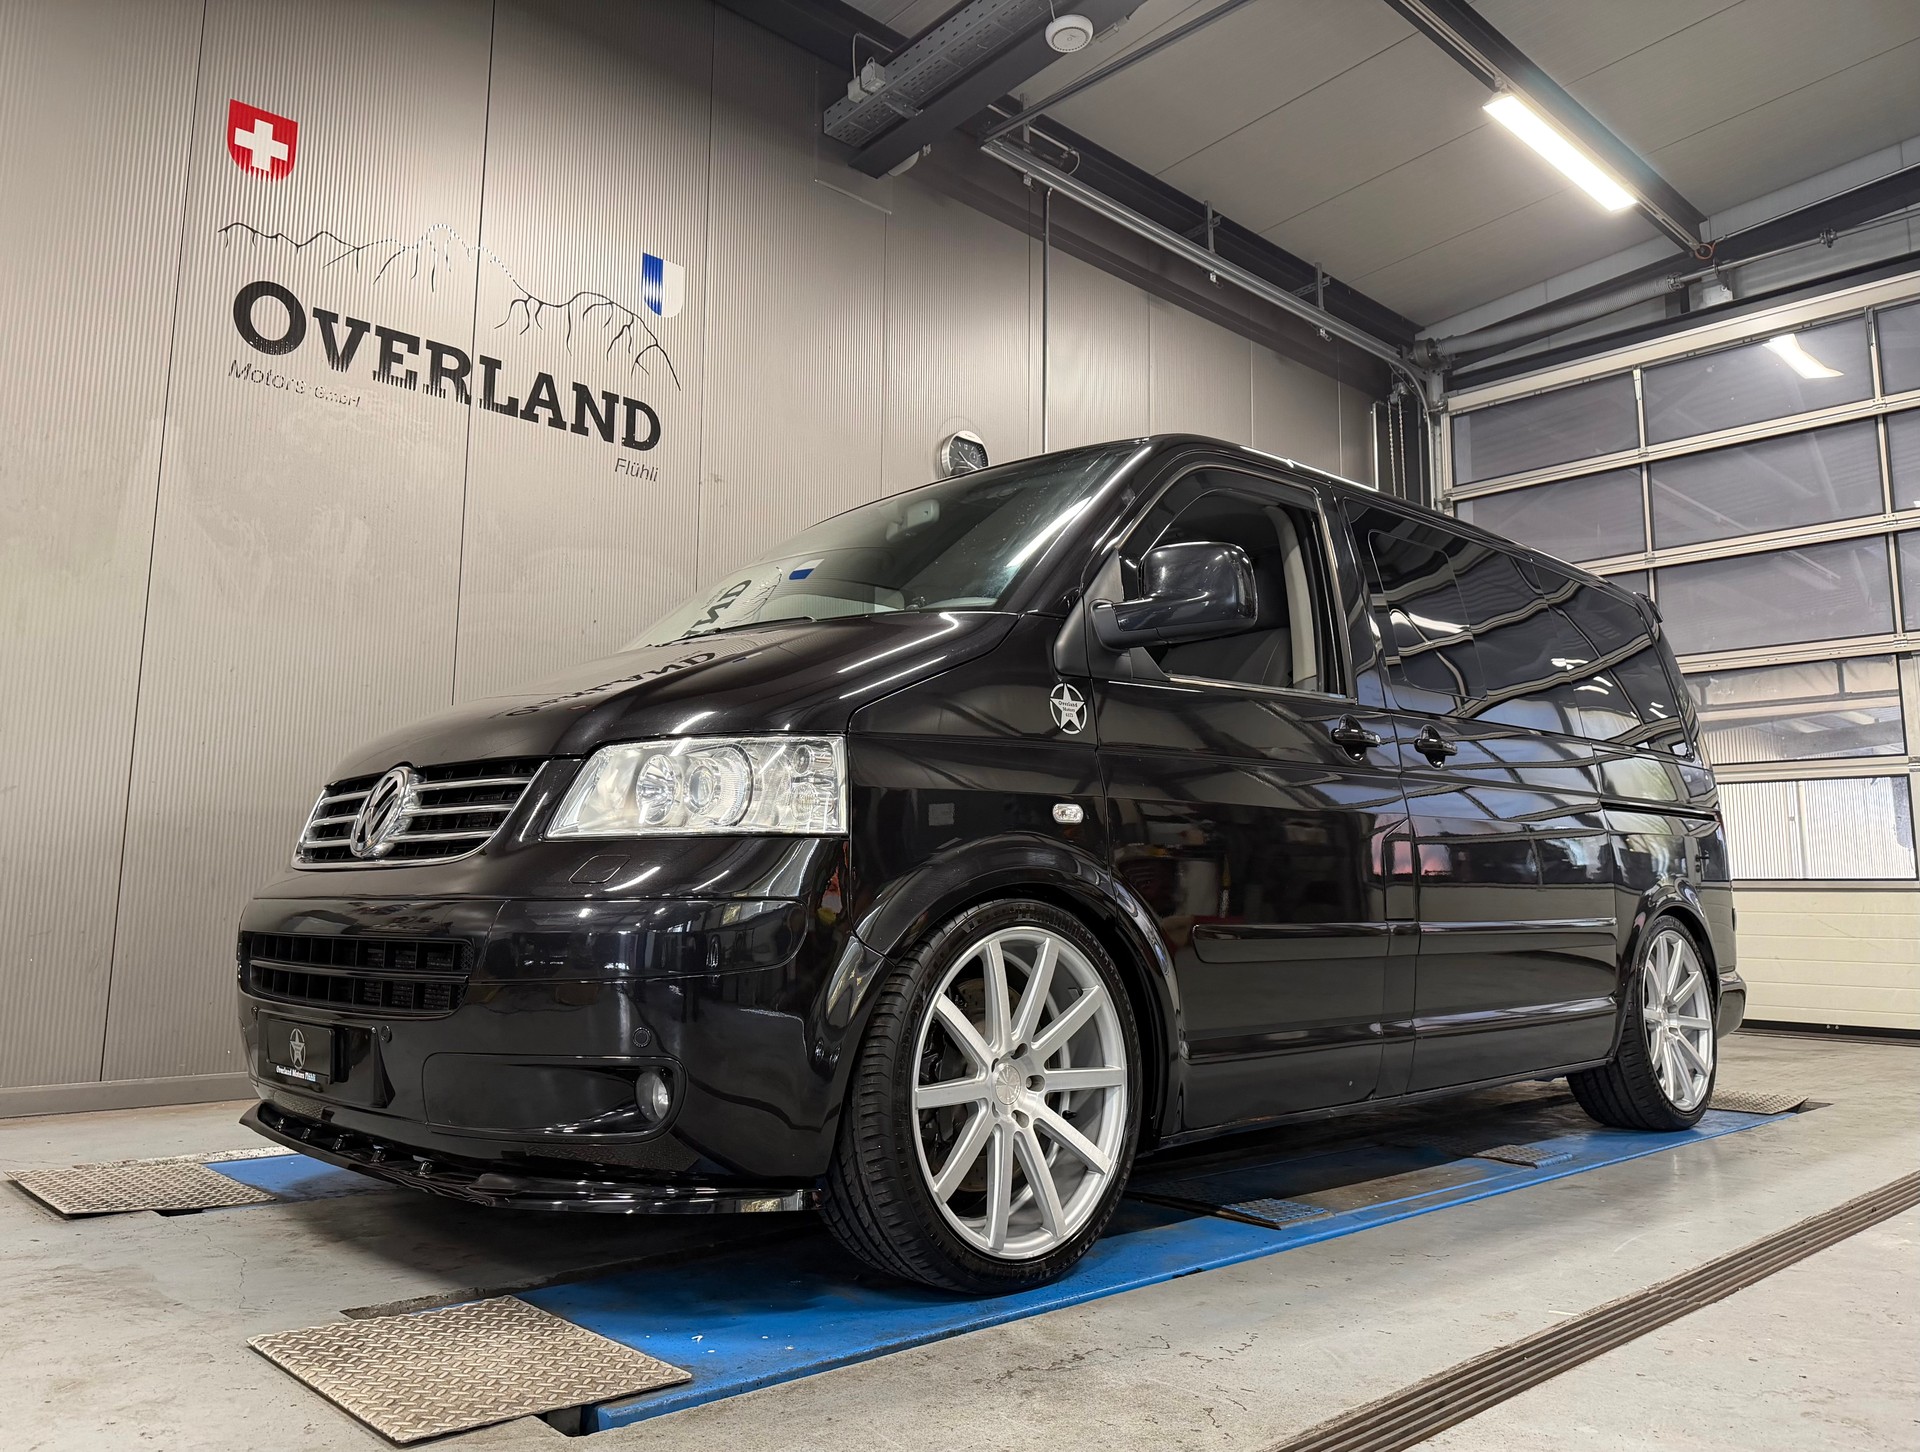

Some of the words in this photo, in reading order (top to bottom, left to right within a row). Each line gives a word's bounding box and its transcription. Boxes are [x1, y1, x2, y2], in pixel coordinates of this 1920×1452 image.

[228, 359, 306, 394] Motors
[314, 386, 361, 407] GmbH
[233, 281, 662, 451] OVERLAND
[614, 457, 659, 482] Flühli
